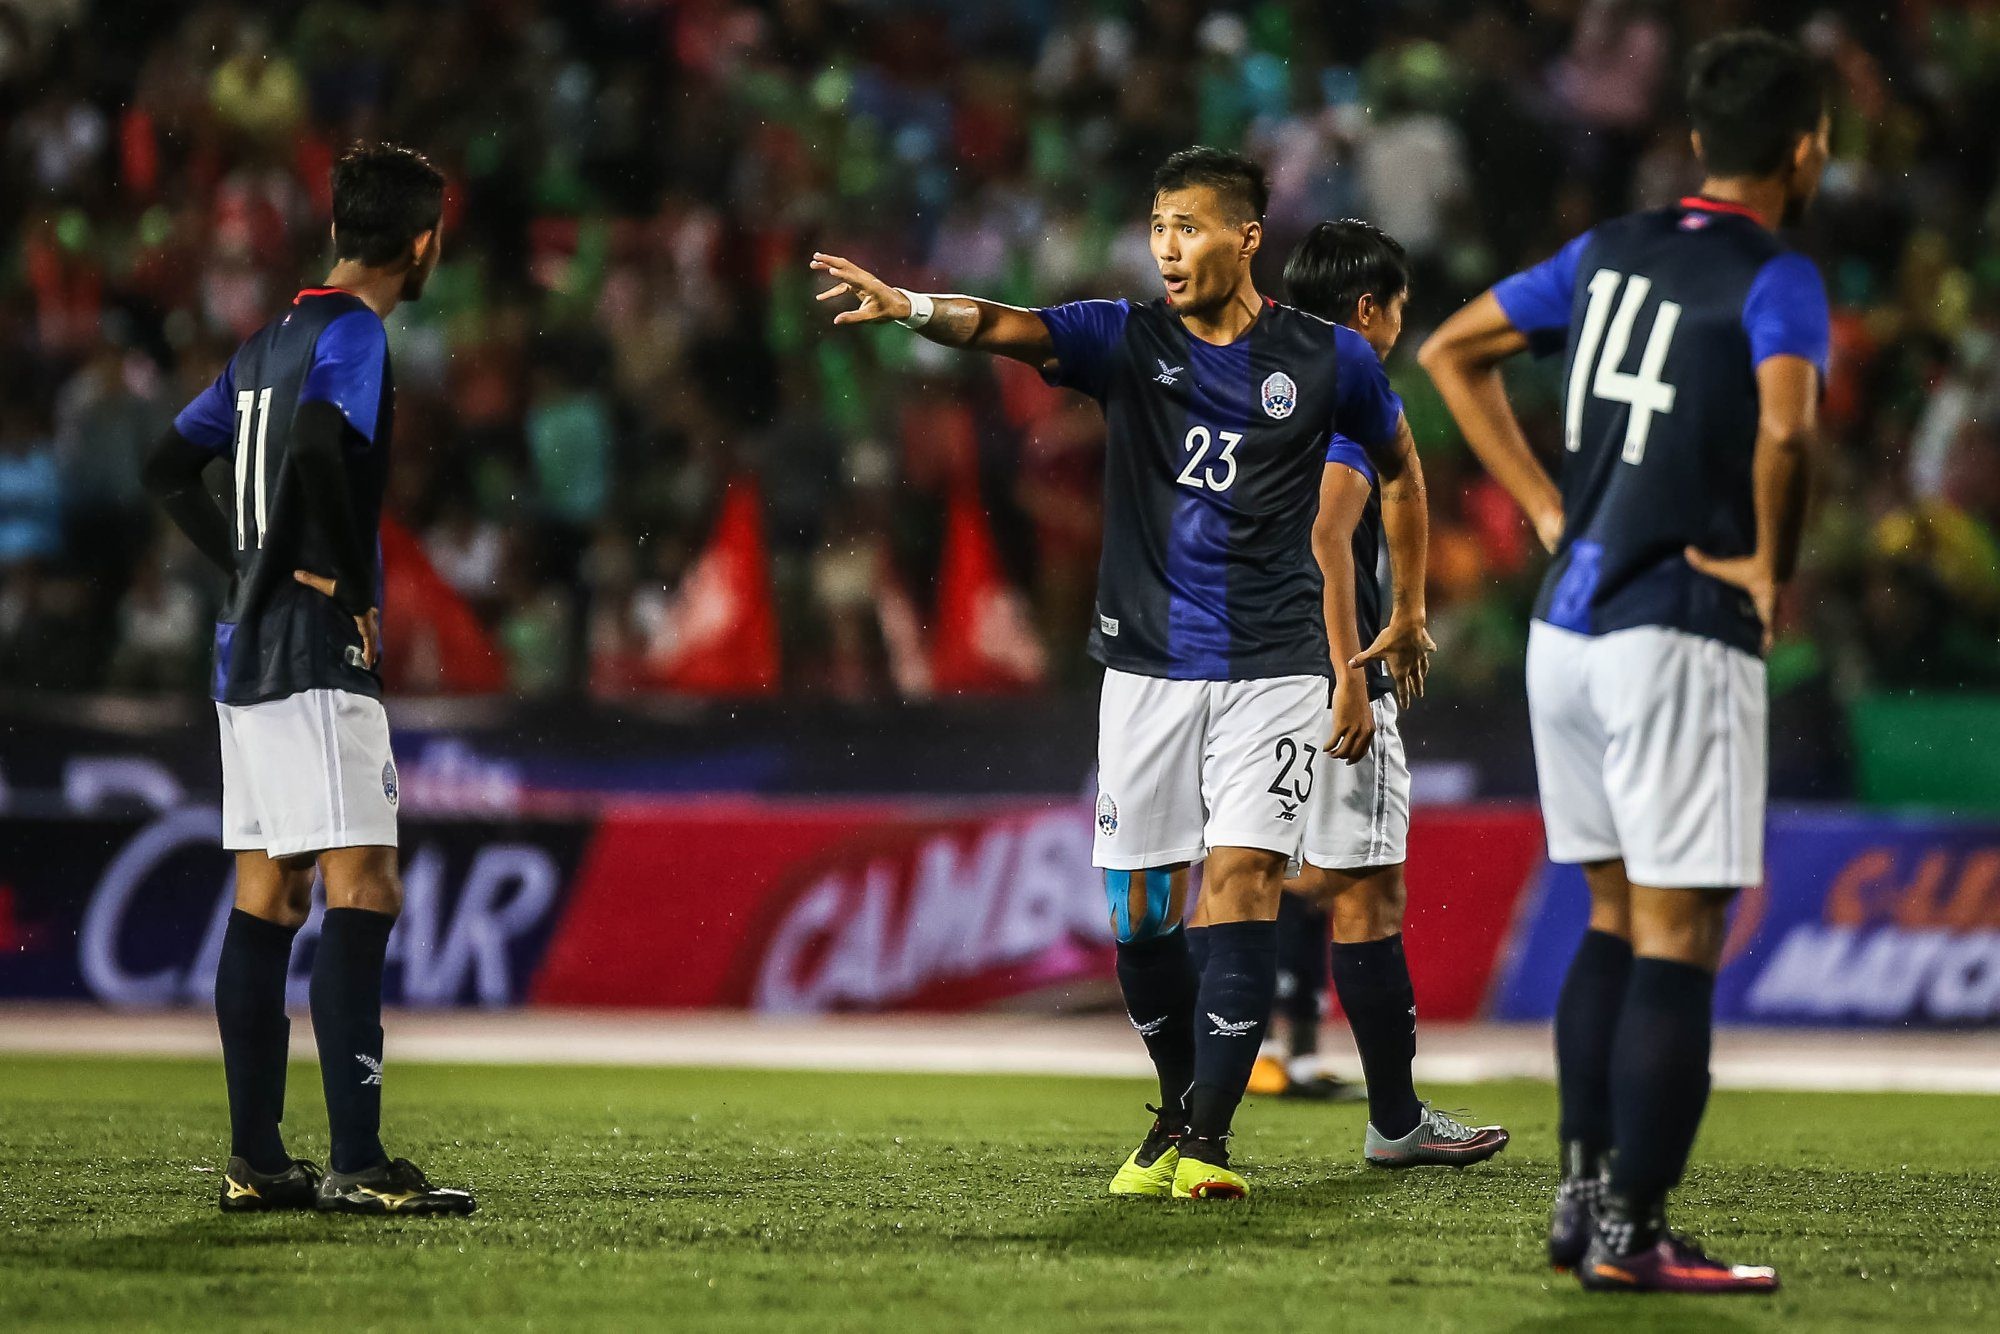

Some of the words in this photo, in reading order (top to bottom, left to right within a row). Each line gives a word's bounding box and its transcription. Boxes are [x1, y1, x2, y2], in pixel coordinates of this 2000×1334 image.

[1565, 268, 1682, 465] 14
[235, 387, 272, 551] 11
[1176, 426, 1243, 491] 23
[1267, 737, 1317, 803] 23
